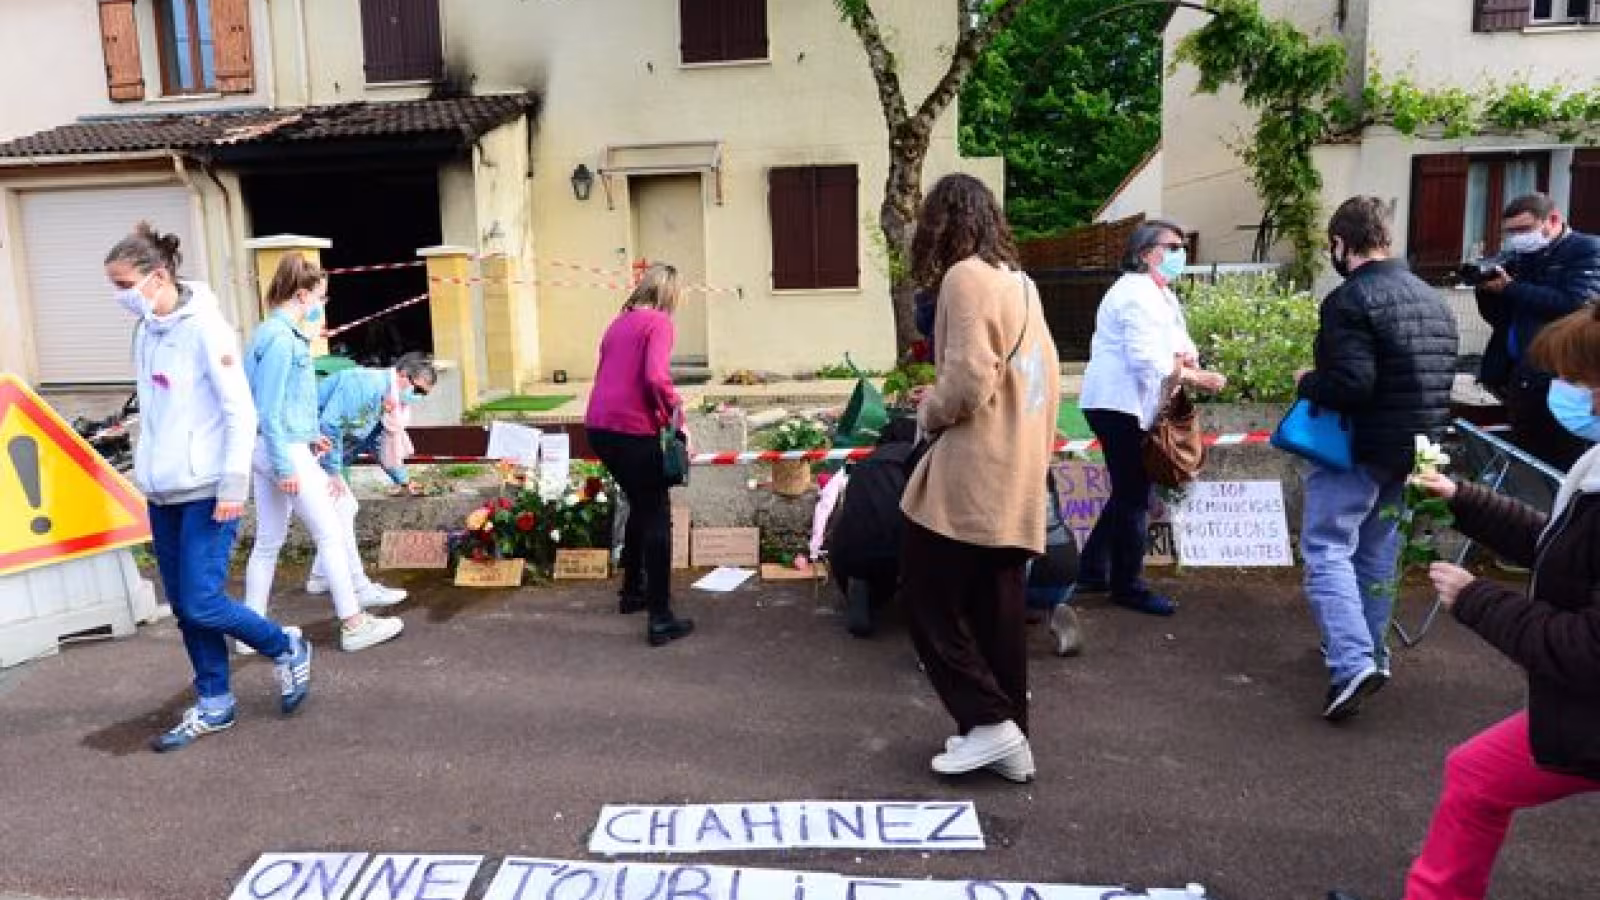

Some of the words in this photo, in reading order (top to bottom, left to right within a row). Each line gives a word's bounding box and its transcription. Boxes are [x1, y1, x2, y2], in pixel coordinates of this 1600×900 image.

[1209, 483, 1246, 498] STOP
[249, 856, 353, 900] ON
[358, 858, 477, 900] NE
